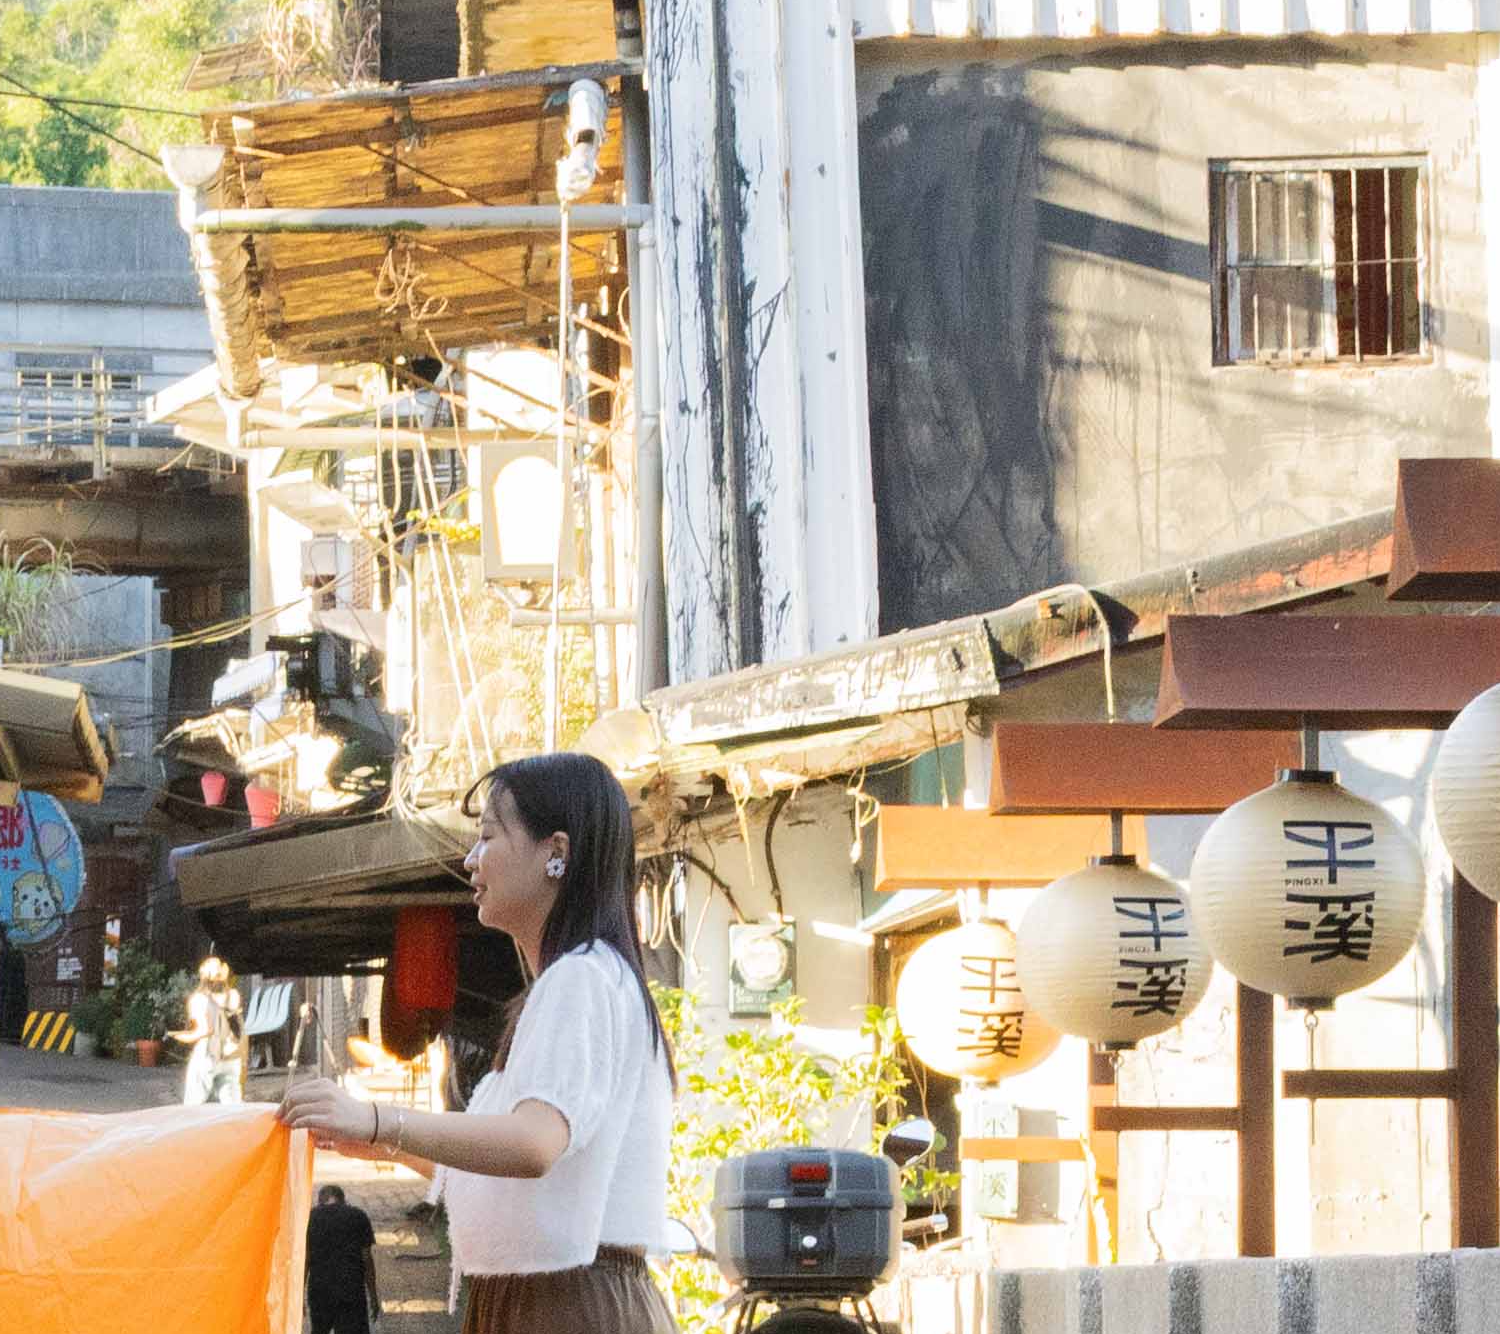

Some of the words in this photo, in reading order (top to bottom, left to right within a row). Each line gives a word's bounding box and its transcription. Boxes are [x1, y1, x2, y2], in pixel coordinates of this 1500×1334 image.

[1282, 820, 1376, 966] 平溪
[957, 956, 1025, 1059] 平溪
[1110, 897, 1190, 1018] 平溪
